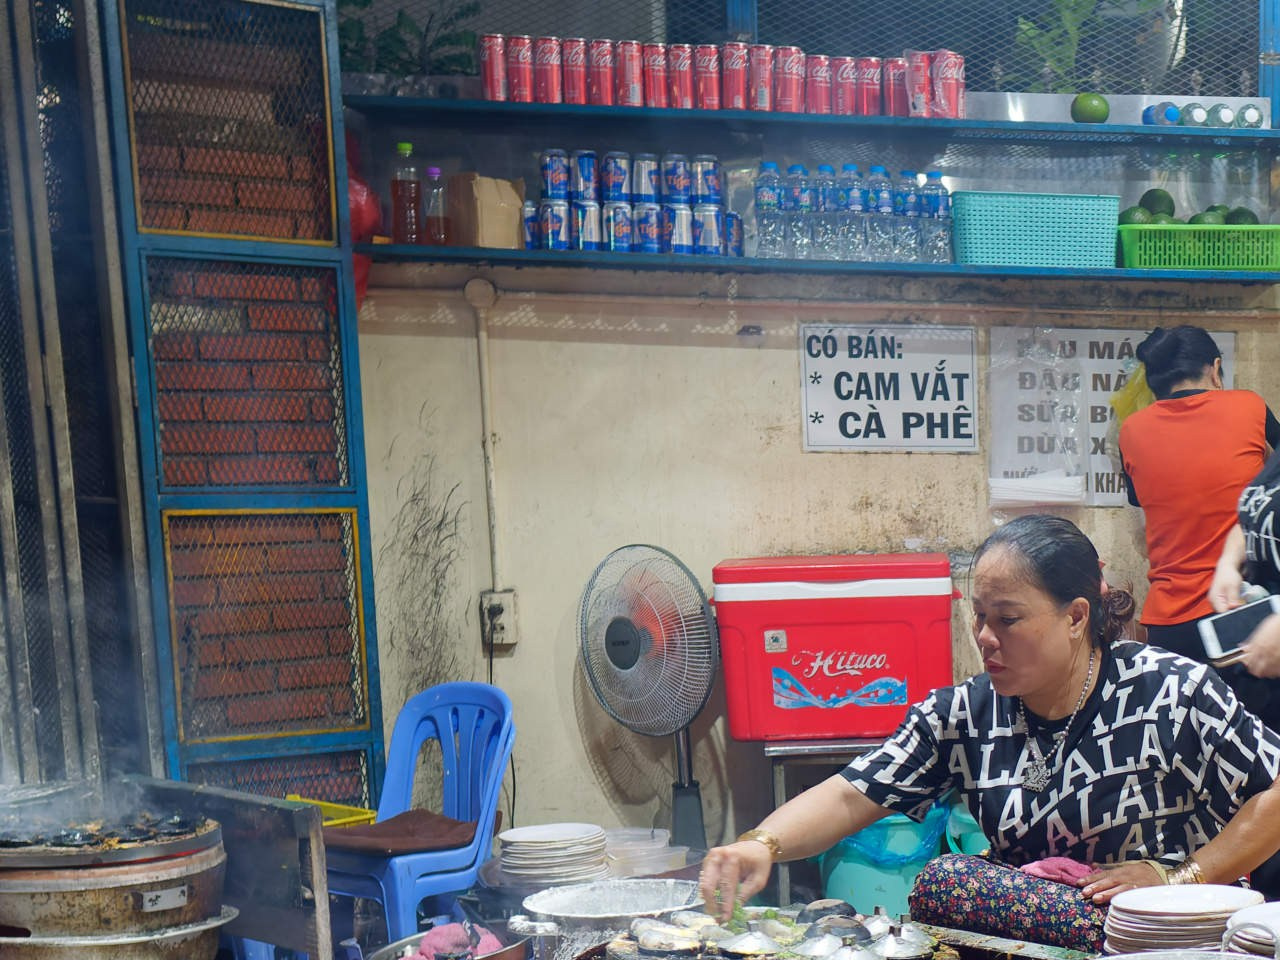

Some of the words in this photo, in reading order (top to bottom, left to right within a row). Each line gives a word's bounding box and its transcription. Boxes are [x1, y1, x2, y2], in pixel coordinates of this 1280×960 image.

[806, 329, 838, 358] CÓ
[847, 329, 903, 359] BÁN:
[834, 371, 900, 401] CAM
[911, 359, 969, 401] VẮT
[838, 404, 886, 439] CÀ
[902, 405, 973, 439] PHÊ
